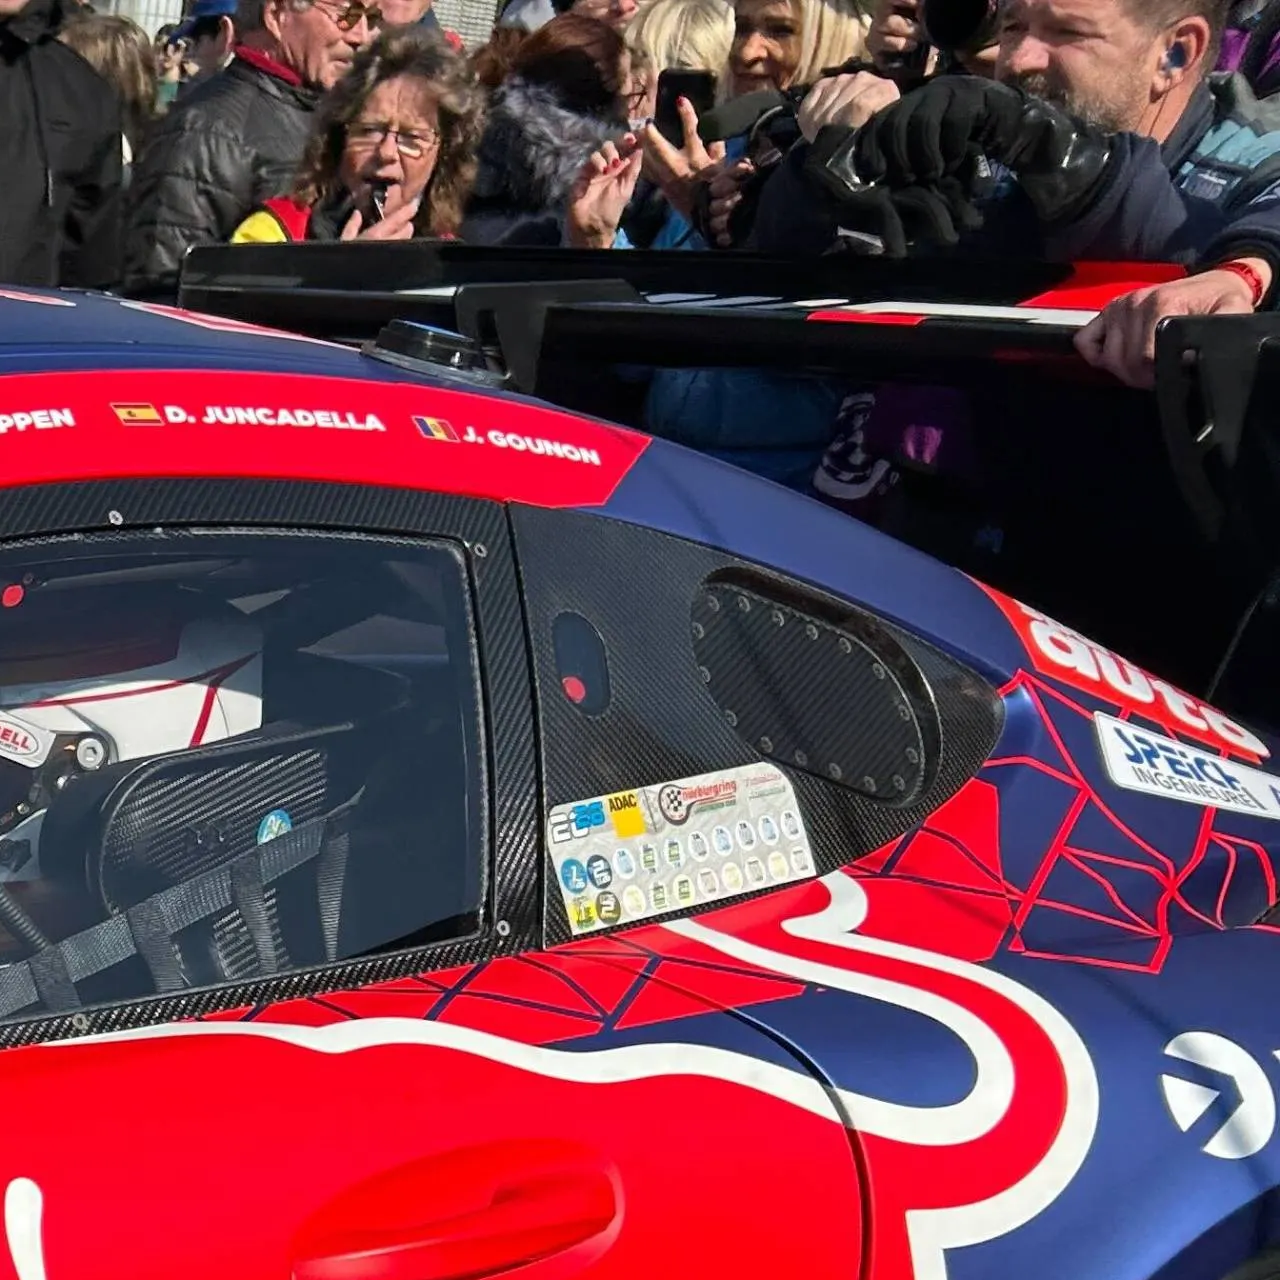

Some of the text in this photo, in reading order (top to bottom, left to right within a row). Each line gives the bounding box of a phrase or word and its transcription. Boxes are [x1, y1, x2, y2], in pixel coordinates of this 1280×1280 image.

[165, 405, 386, 432] D. JUNCADELLA
[462, 425, 600, 466] J. GOUNON
[608, 793, 638, 813] ADAC
